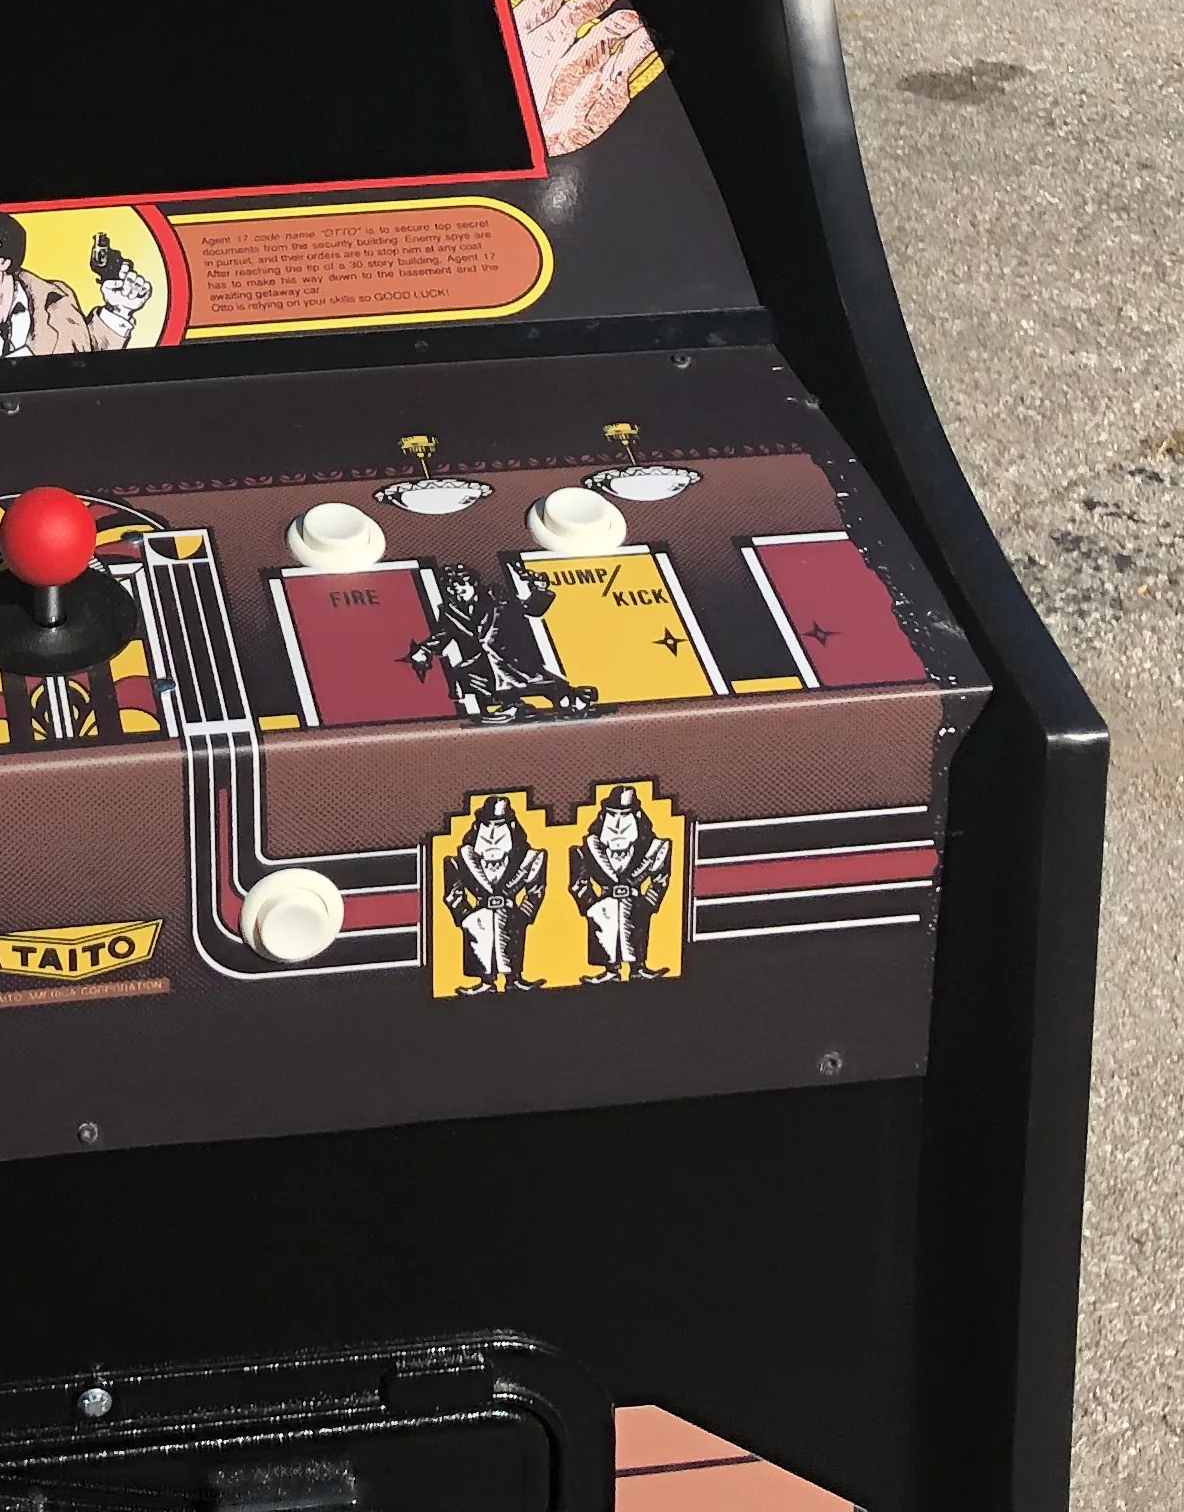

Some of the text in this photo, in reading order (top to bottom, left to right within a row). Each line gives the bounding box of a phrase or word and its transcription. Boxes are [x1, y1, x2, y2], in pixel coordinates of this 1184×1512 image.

[201, 236, 231, 248] Agent
[379, 226, 390, 234] to
[396, 225, 429, 233] secure
[435, 222, 451, 232] top
[456, 219, 489, 229] secret
[202, 246, 259, 257] documents
[264, 245, 287, 253] from
[292, 243, 308, 251] the
[405, 235, 441, 244] Enemy
[259, 255, 277, 264] and
[364, 248, 374, 257] to
[377, 247, 399, 257] stop
[426, 244, 434, 253] at
[437, 245, 456, 253] any
[207, 270, 230, 279] After
[236, 267, 281, 277] reaching
[286, 265, 302, 273] the
[323, 262, 334, 271] of
[367, 259, 394, 269] story
[447, 253, 478, 264] Agent
[207, 282, 227, 290] has
[231, 280, 241, 289] to
[246, 278, 276, 288] make
[302, 277, 323, 285] way
[329, 274, 357, 282] down
[361, 272, 372, 280] to
[377, 270, 394, 279] the
[399, 266, 452, 277] basement
[456, 264, 476, 274] and
[209, 291, 252, 302] awaiting
[256, 289, 300, 300] getaway
[211, 304, 234, 313] Otto
[248, 300, 283, 311] relying
[304, 299, 326, 308] your
[374, 291, 410, 301] GOOD
[329, 590, 381, 608] FIRE
[12, 935, 136, 972] TAITO
